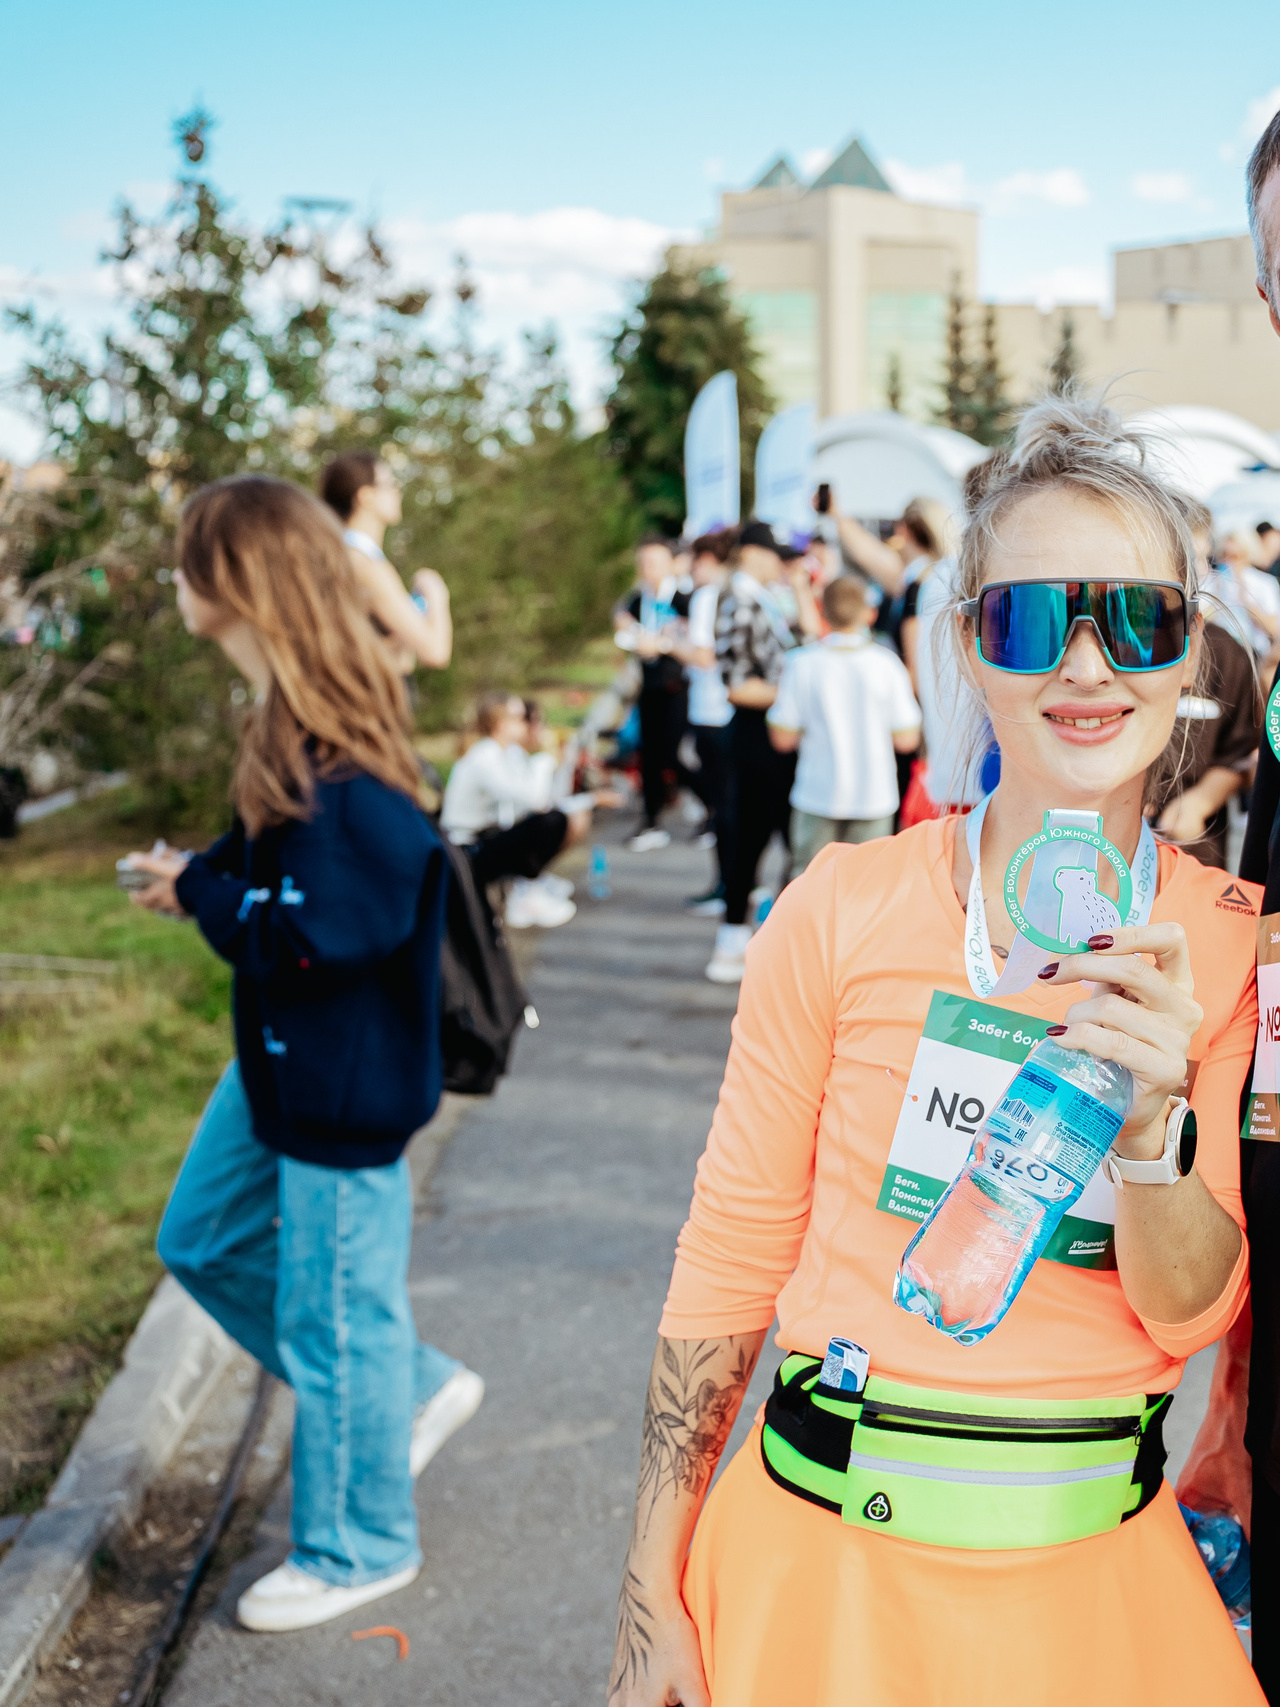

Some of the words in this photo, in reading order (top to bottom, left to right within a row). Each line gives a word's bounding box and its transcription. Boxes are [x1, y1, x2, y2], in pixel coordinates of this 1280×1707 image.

[1050, 828, 1101, 846] Южного
[1007, 834, 1048, 893] волонтёров
[1102, 842, 1127, 878] Урала
[1135, 844, 1155, 904] Забег
[1008, 898, 1029, 932] Забег
[1215, 900, 1257, 917] Reebok
[968, 1018, 1010, 1039] Забег
[894, 1174, 920, 1191] Беги.
